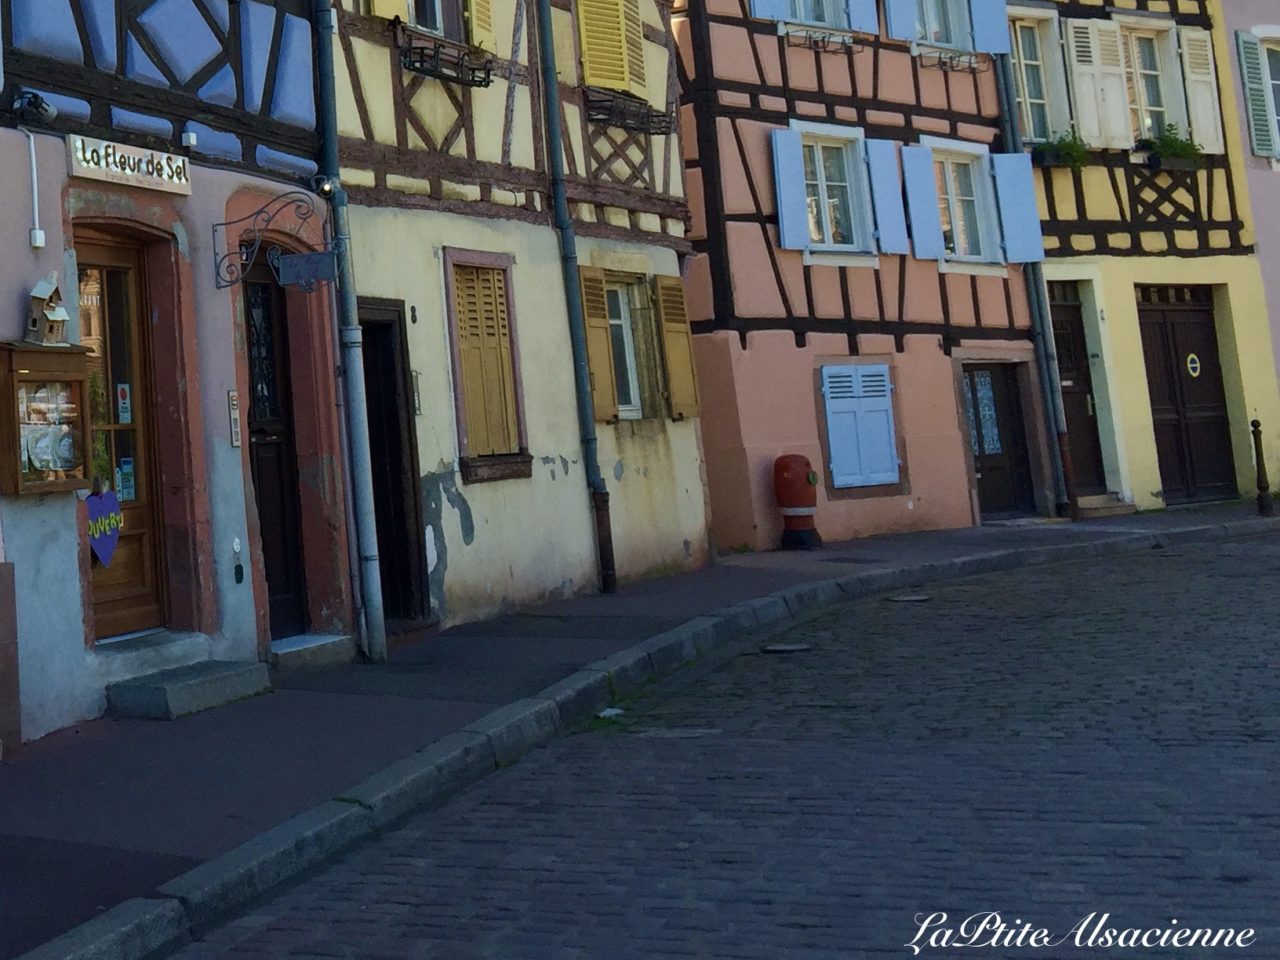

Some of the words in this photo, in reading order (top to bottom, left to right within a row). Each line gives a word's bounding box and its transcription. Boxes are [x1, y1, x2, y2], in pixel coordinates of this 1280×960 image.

[80, 138, 100, 166] La
[104, 144, 143, 173] Fleur
[146, 152, 163, 178] de
[166, 155, 189, 182] Sel
[410, 304, 418, 325] 8
